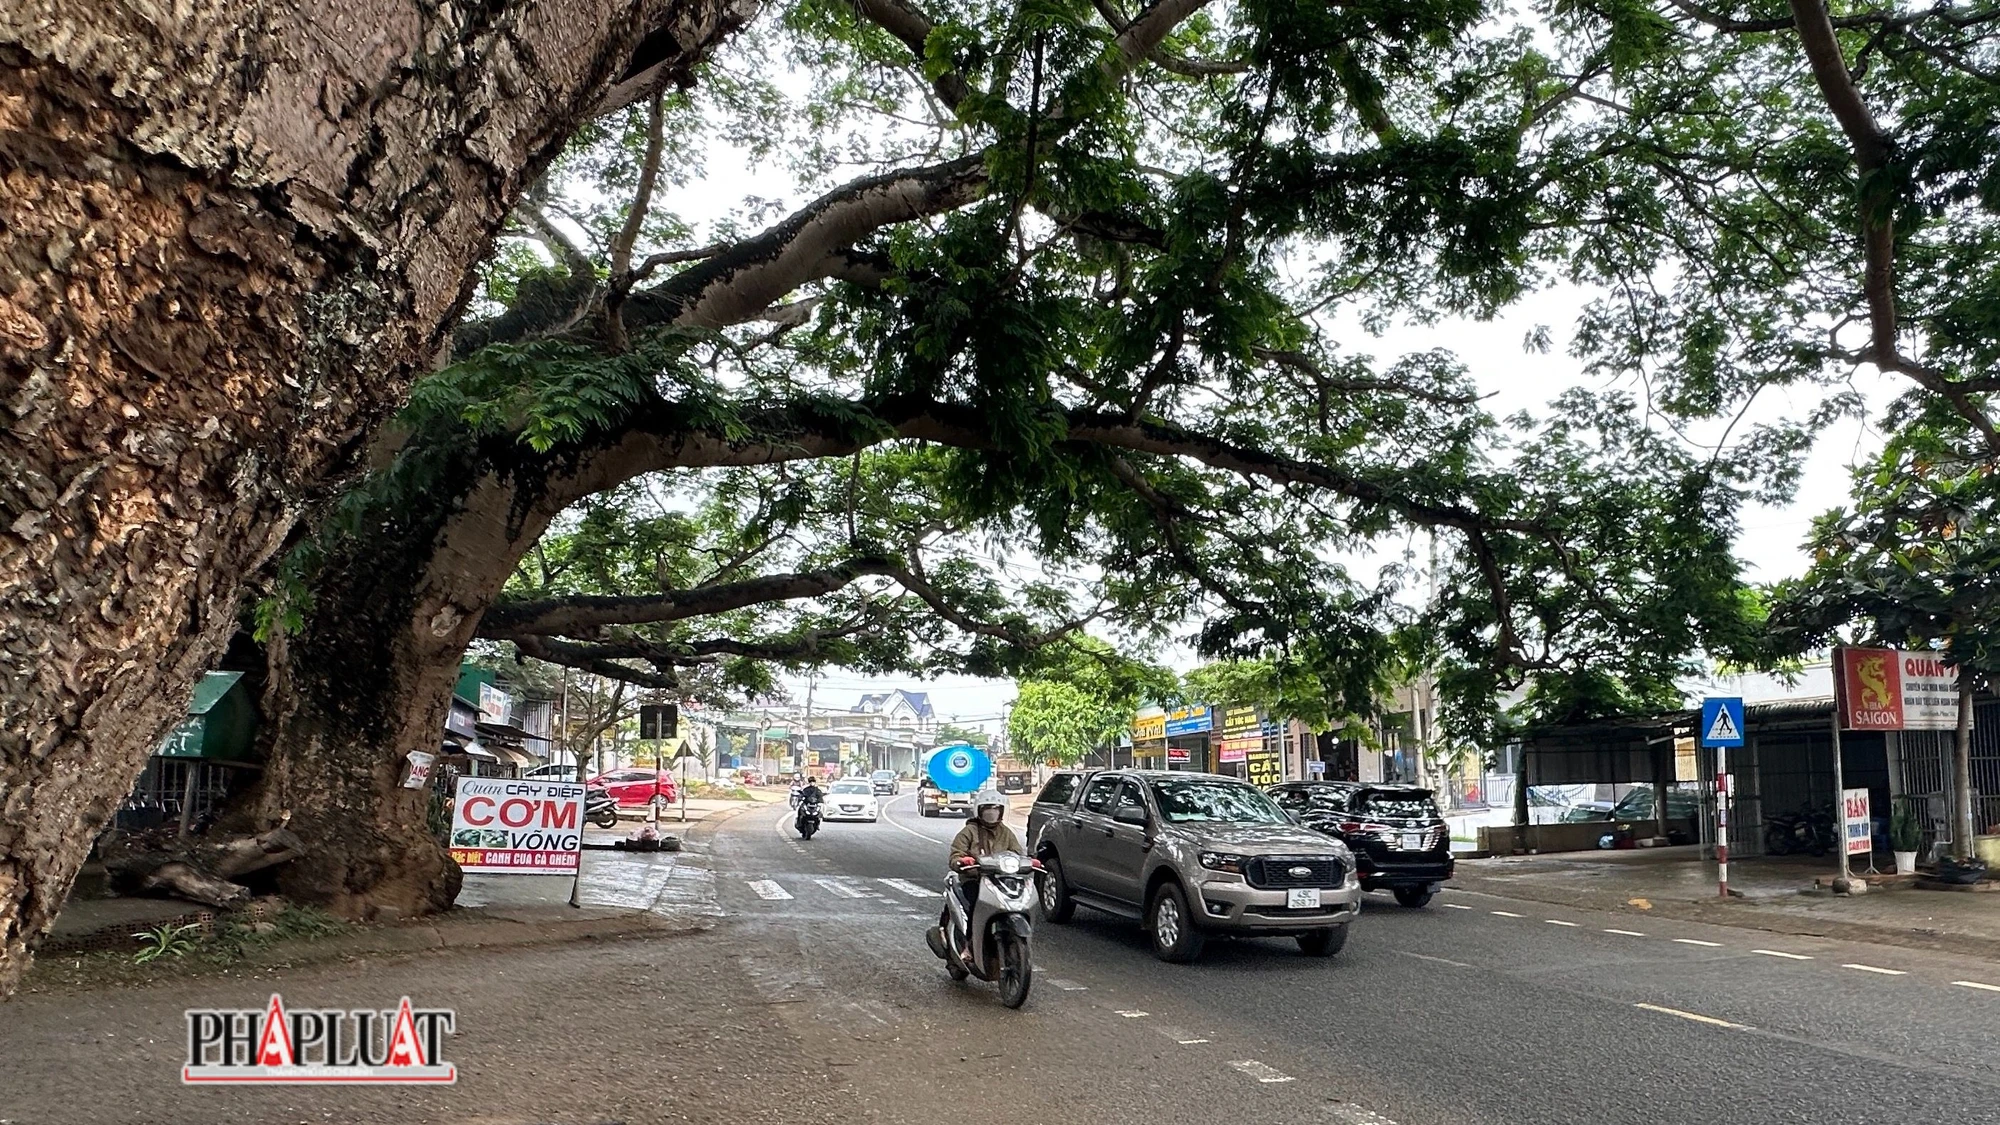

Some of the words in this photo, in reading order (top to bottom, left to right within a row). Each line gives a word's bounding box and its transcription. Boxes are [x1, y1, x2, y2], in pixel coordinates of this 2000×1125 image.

[1856, 710, 1898, 725] SAIGON
[462, 780, 503, 796] Quán
[505, 782, 542, 797] CÂY
[547, 785, 584, 801] ĐIỆP
[462, 796, 578, 830] CƠM
[1845, 791, 1868, 819] BÁN
[511, 829, 579, 851] VÕNG
[485, 851, 511, 865] CANH
[513, 852, 532, 865] CUA
